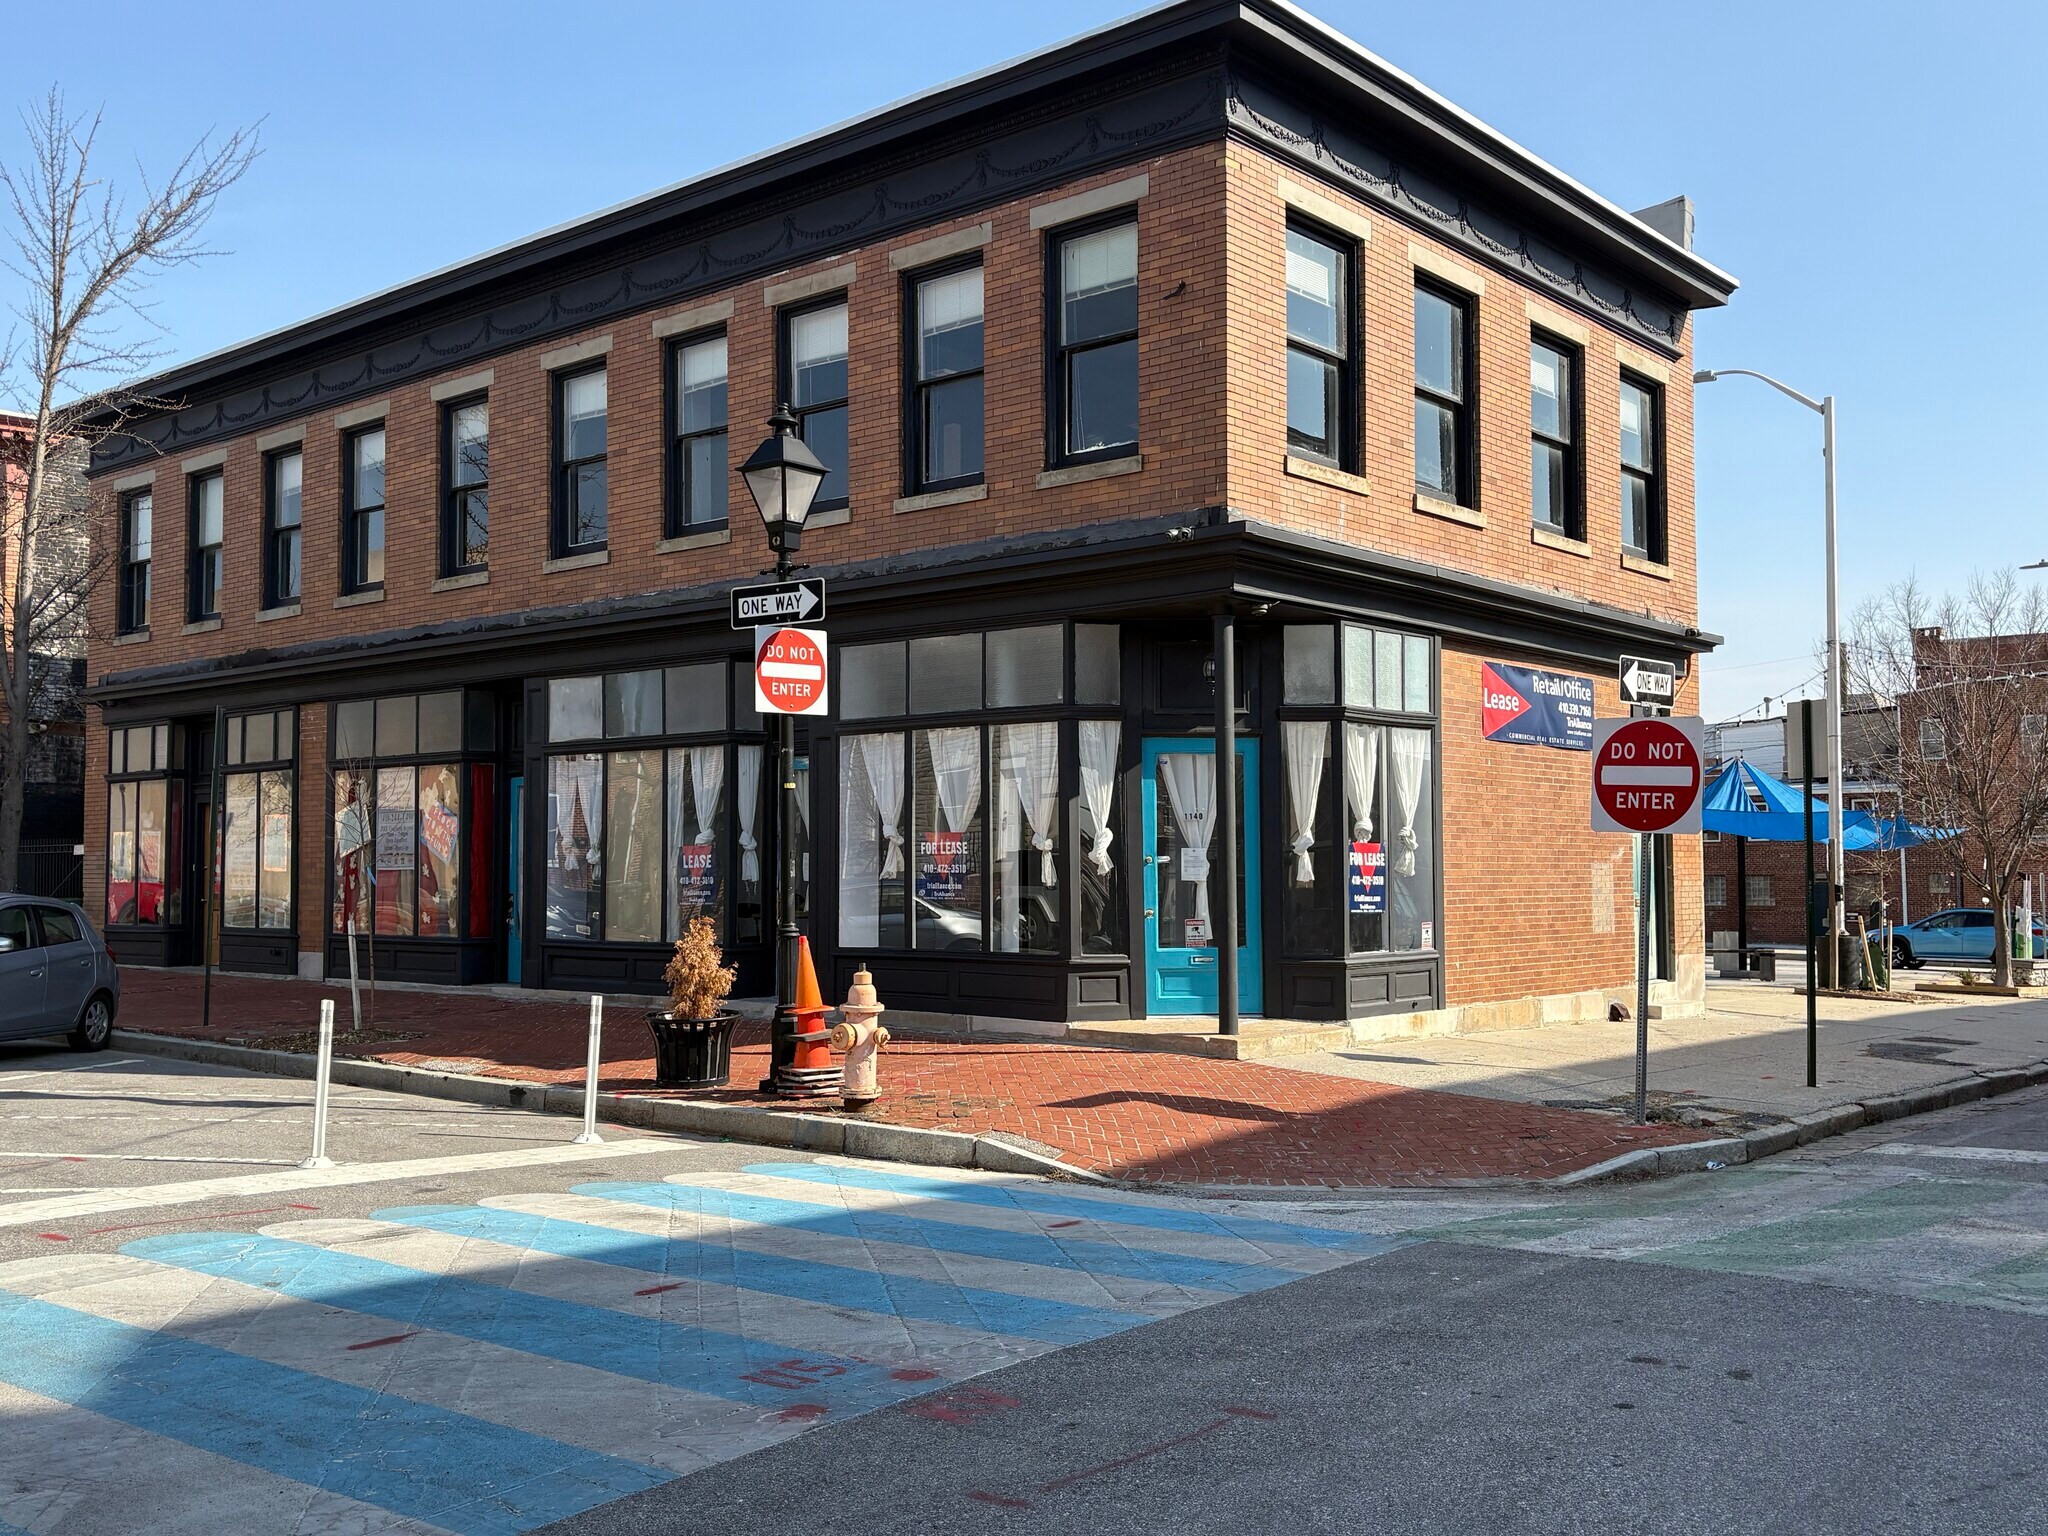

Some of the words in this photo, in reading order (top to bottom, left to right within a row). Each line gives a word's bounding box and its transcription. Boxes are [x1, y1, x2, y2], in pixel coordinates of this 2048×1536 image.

[742, 598, 768, 615] ONE
[776, 594, 802, 611] WAY
[767, 645, 784, 658] DO
[790, 647, 815, 660] NOT
[772, 682, 811, 697] ENTER
[1532, 676, 1592, 702] Retail/Office
[1636, 673, 1652, 690] ONE
[1654, 676, 1669, 693] WAY
[1484, 688, 1520, 712] Lease
[1611, 742, 1636, 760] DO
[1648, 742, 1684, 760] NOT
[1616, 792, 1675, 810] ENTER
[920, 842, 938, 854] FOR
[940, 842, 968, 854] LEASE
[682, 854, 712, 868] LEASE
[1349, 852, 1363, 866] FOR
[1364, 852, 1385, 866] LEASE
[923, 864, 966, 873] 410-472-3510
